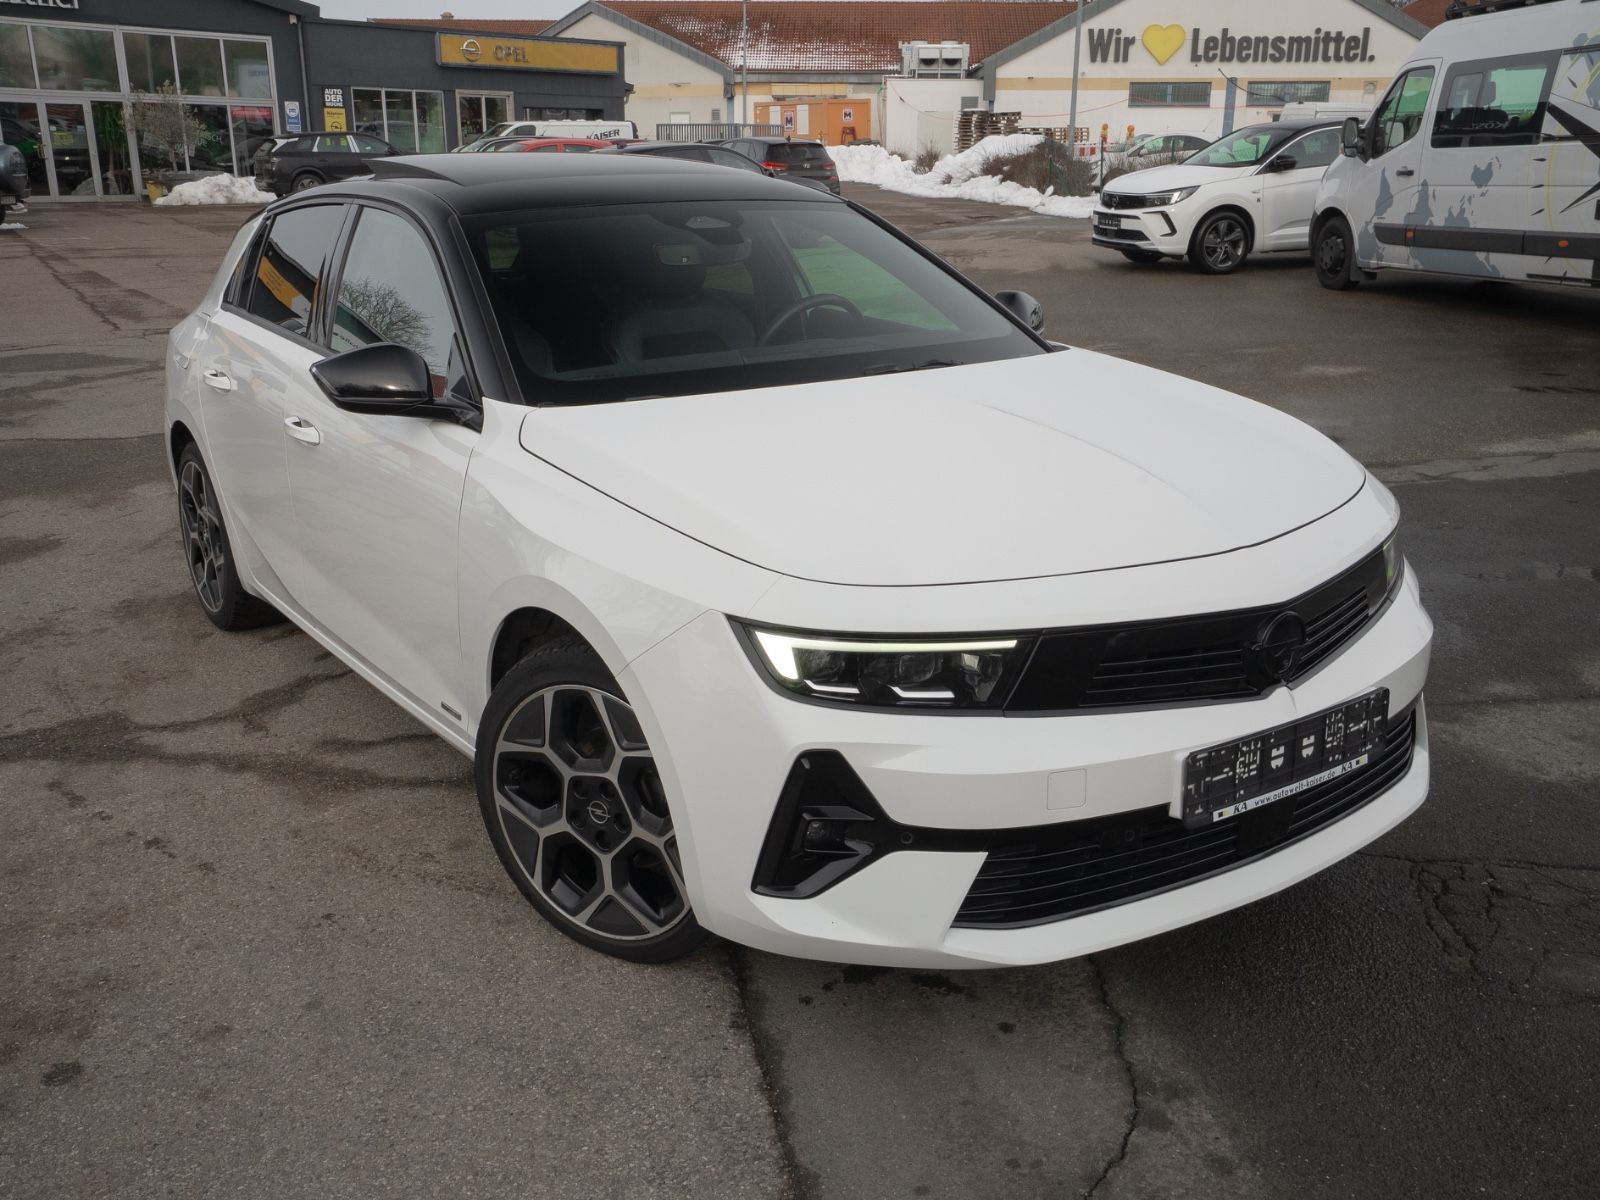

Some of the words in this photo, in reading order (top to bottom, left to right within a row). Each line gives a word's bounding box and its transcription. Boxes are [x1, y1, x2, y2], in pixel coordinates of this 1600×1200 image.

[494, 45, 529, 63] OPEL
[1088, 28, 1136, 63] Wir
[1190, 27, 1376, 64] Lebensmittel.
[1254, 770, 1336, 807] www.autowelt-kaiser.de
